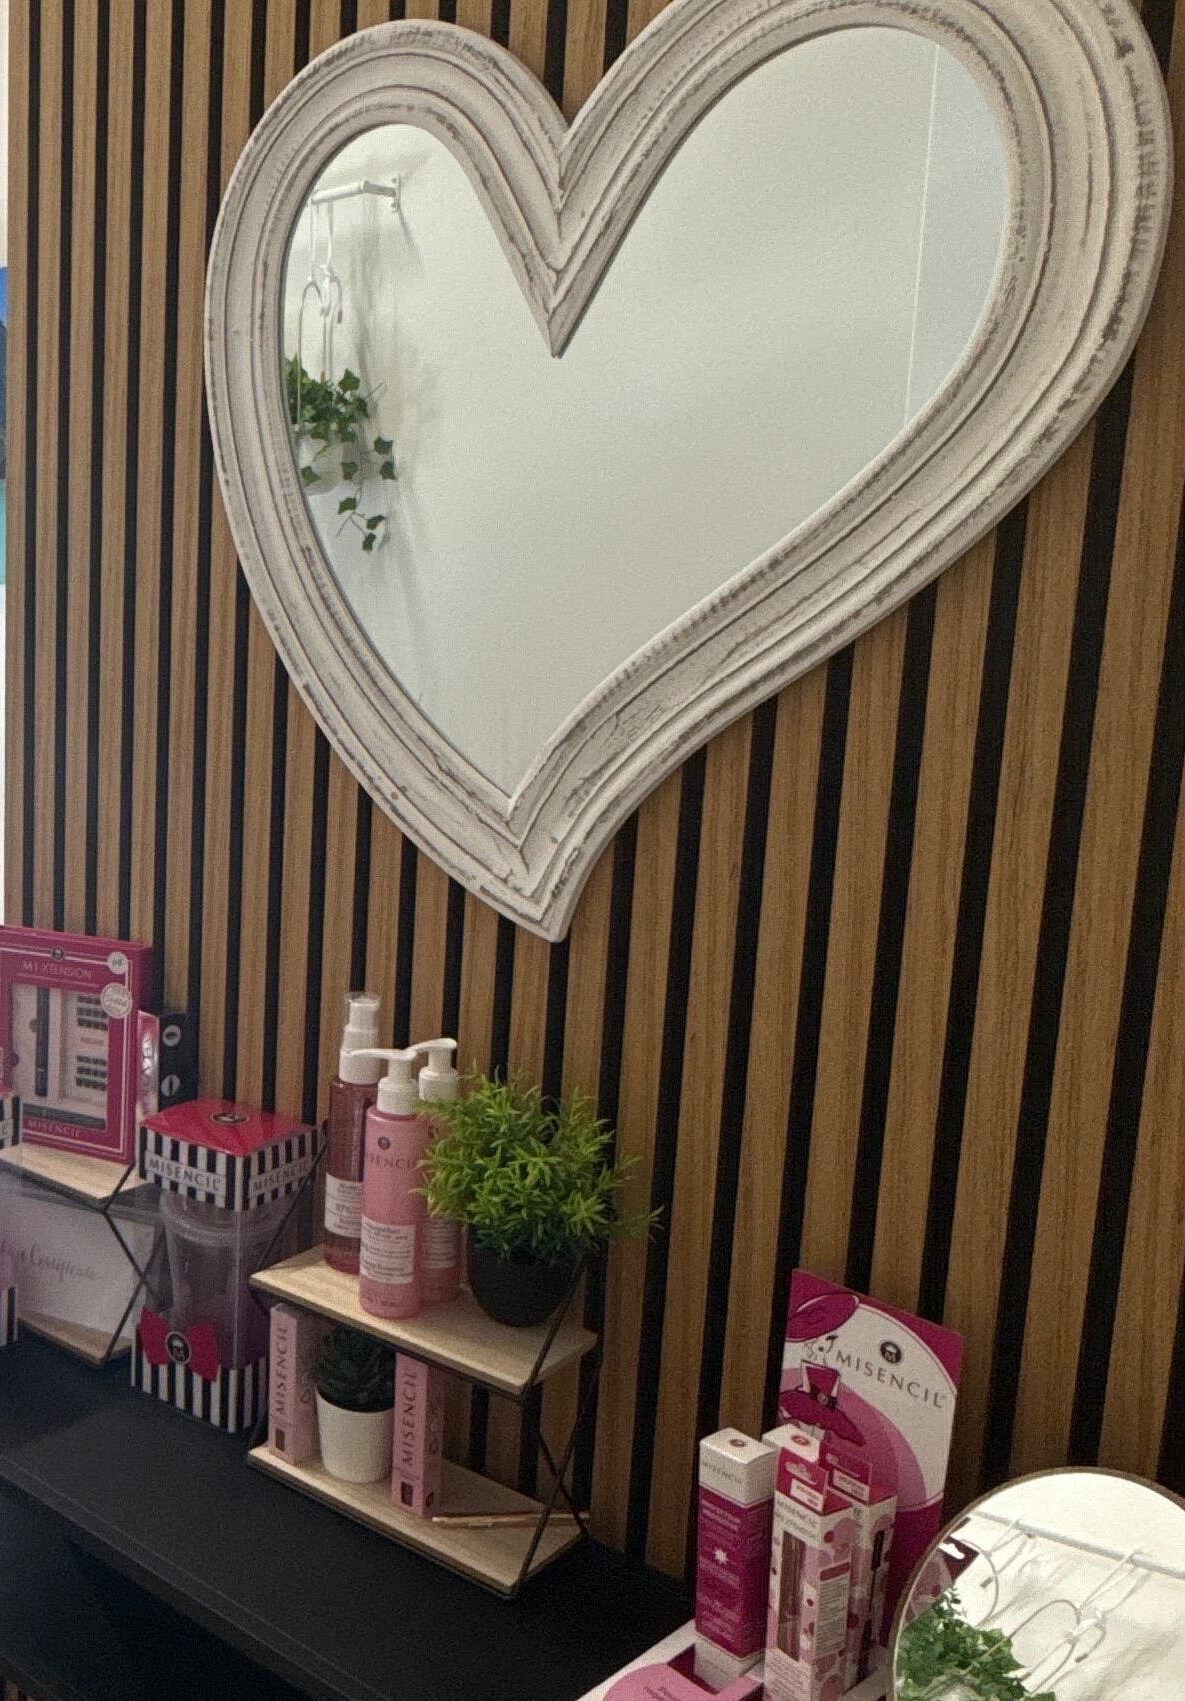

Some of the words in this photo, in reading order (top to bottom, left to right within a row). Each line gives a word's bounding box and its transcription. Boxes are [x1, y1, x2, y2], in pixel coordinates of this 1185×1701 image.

[28, 1117, 81, 1138] MISENCIL
[148, 1157, 221, 1190] MISENCIL
[276, 1326, 288, 1416] MISENCIL
[835, 1349, 944, 1409] MISENCIL
[401, 1372, 417, 1469] MISENCIL
